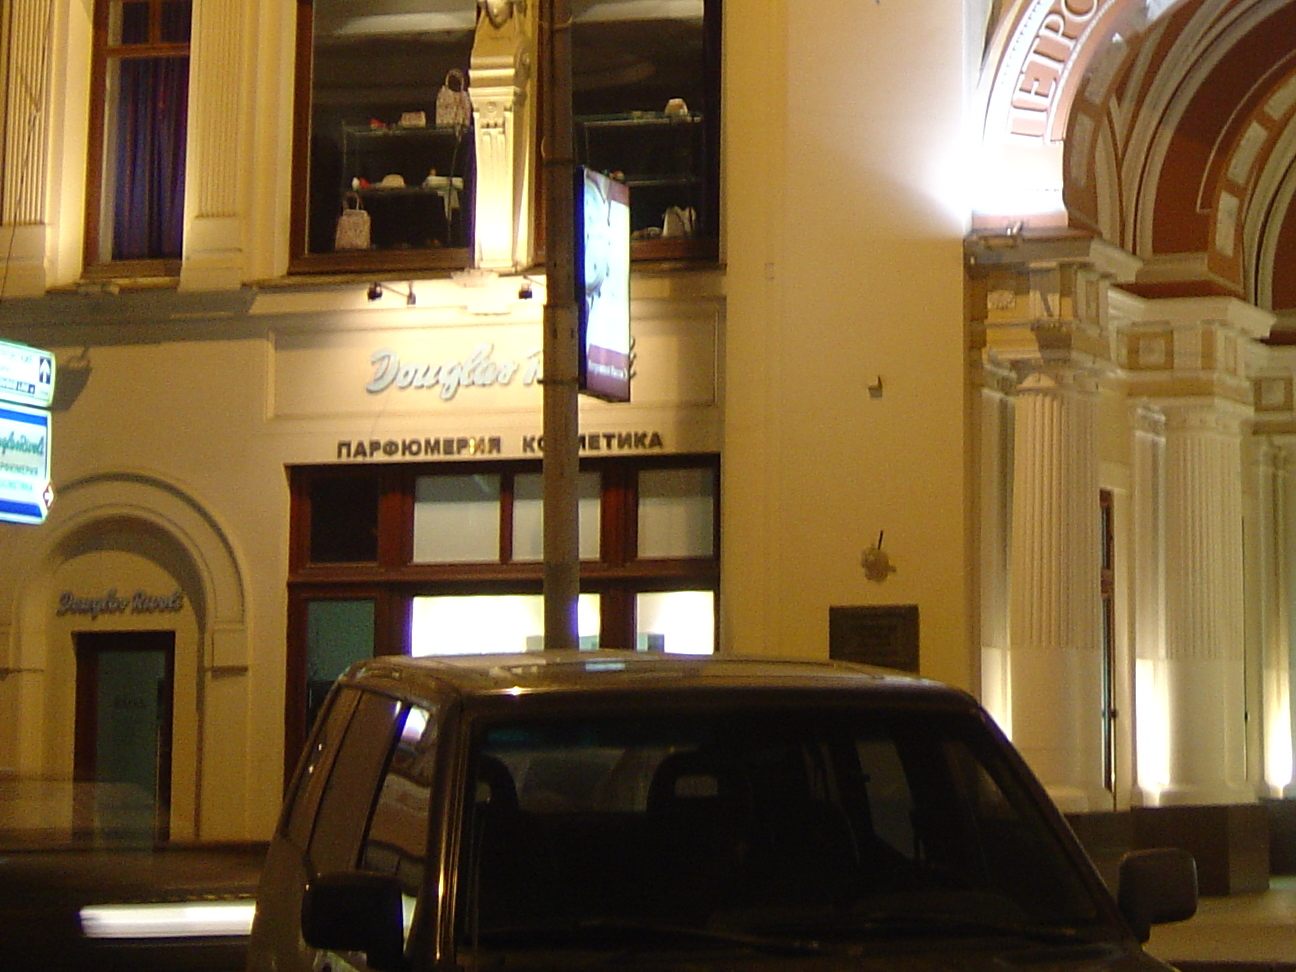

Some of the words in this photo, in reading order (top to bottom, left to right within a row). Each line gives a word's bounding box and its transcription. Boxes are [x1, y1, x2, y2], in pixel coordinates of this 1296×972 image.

[366, 343, 519, 400] Douglas
[337, 438, 501, 459] ПАРФЮМЕРИЯ
[522, 431, 664, 453] КЕТИКА
